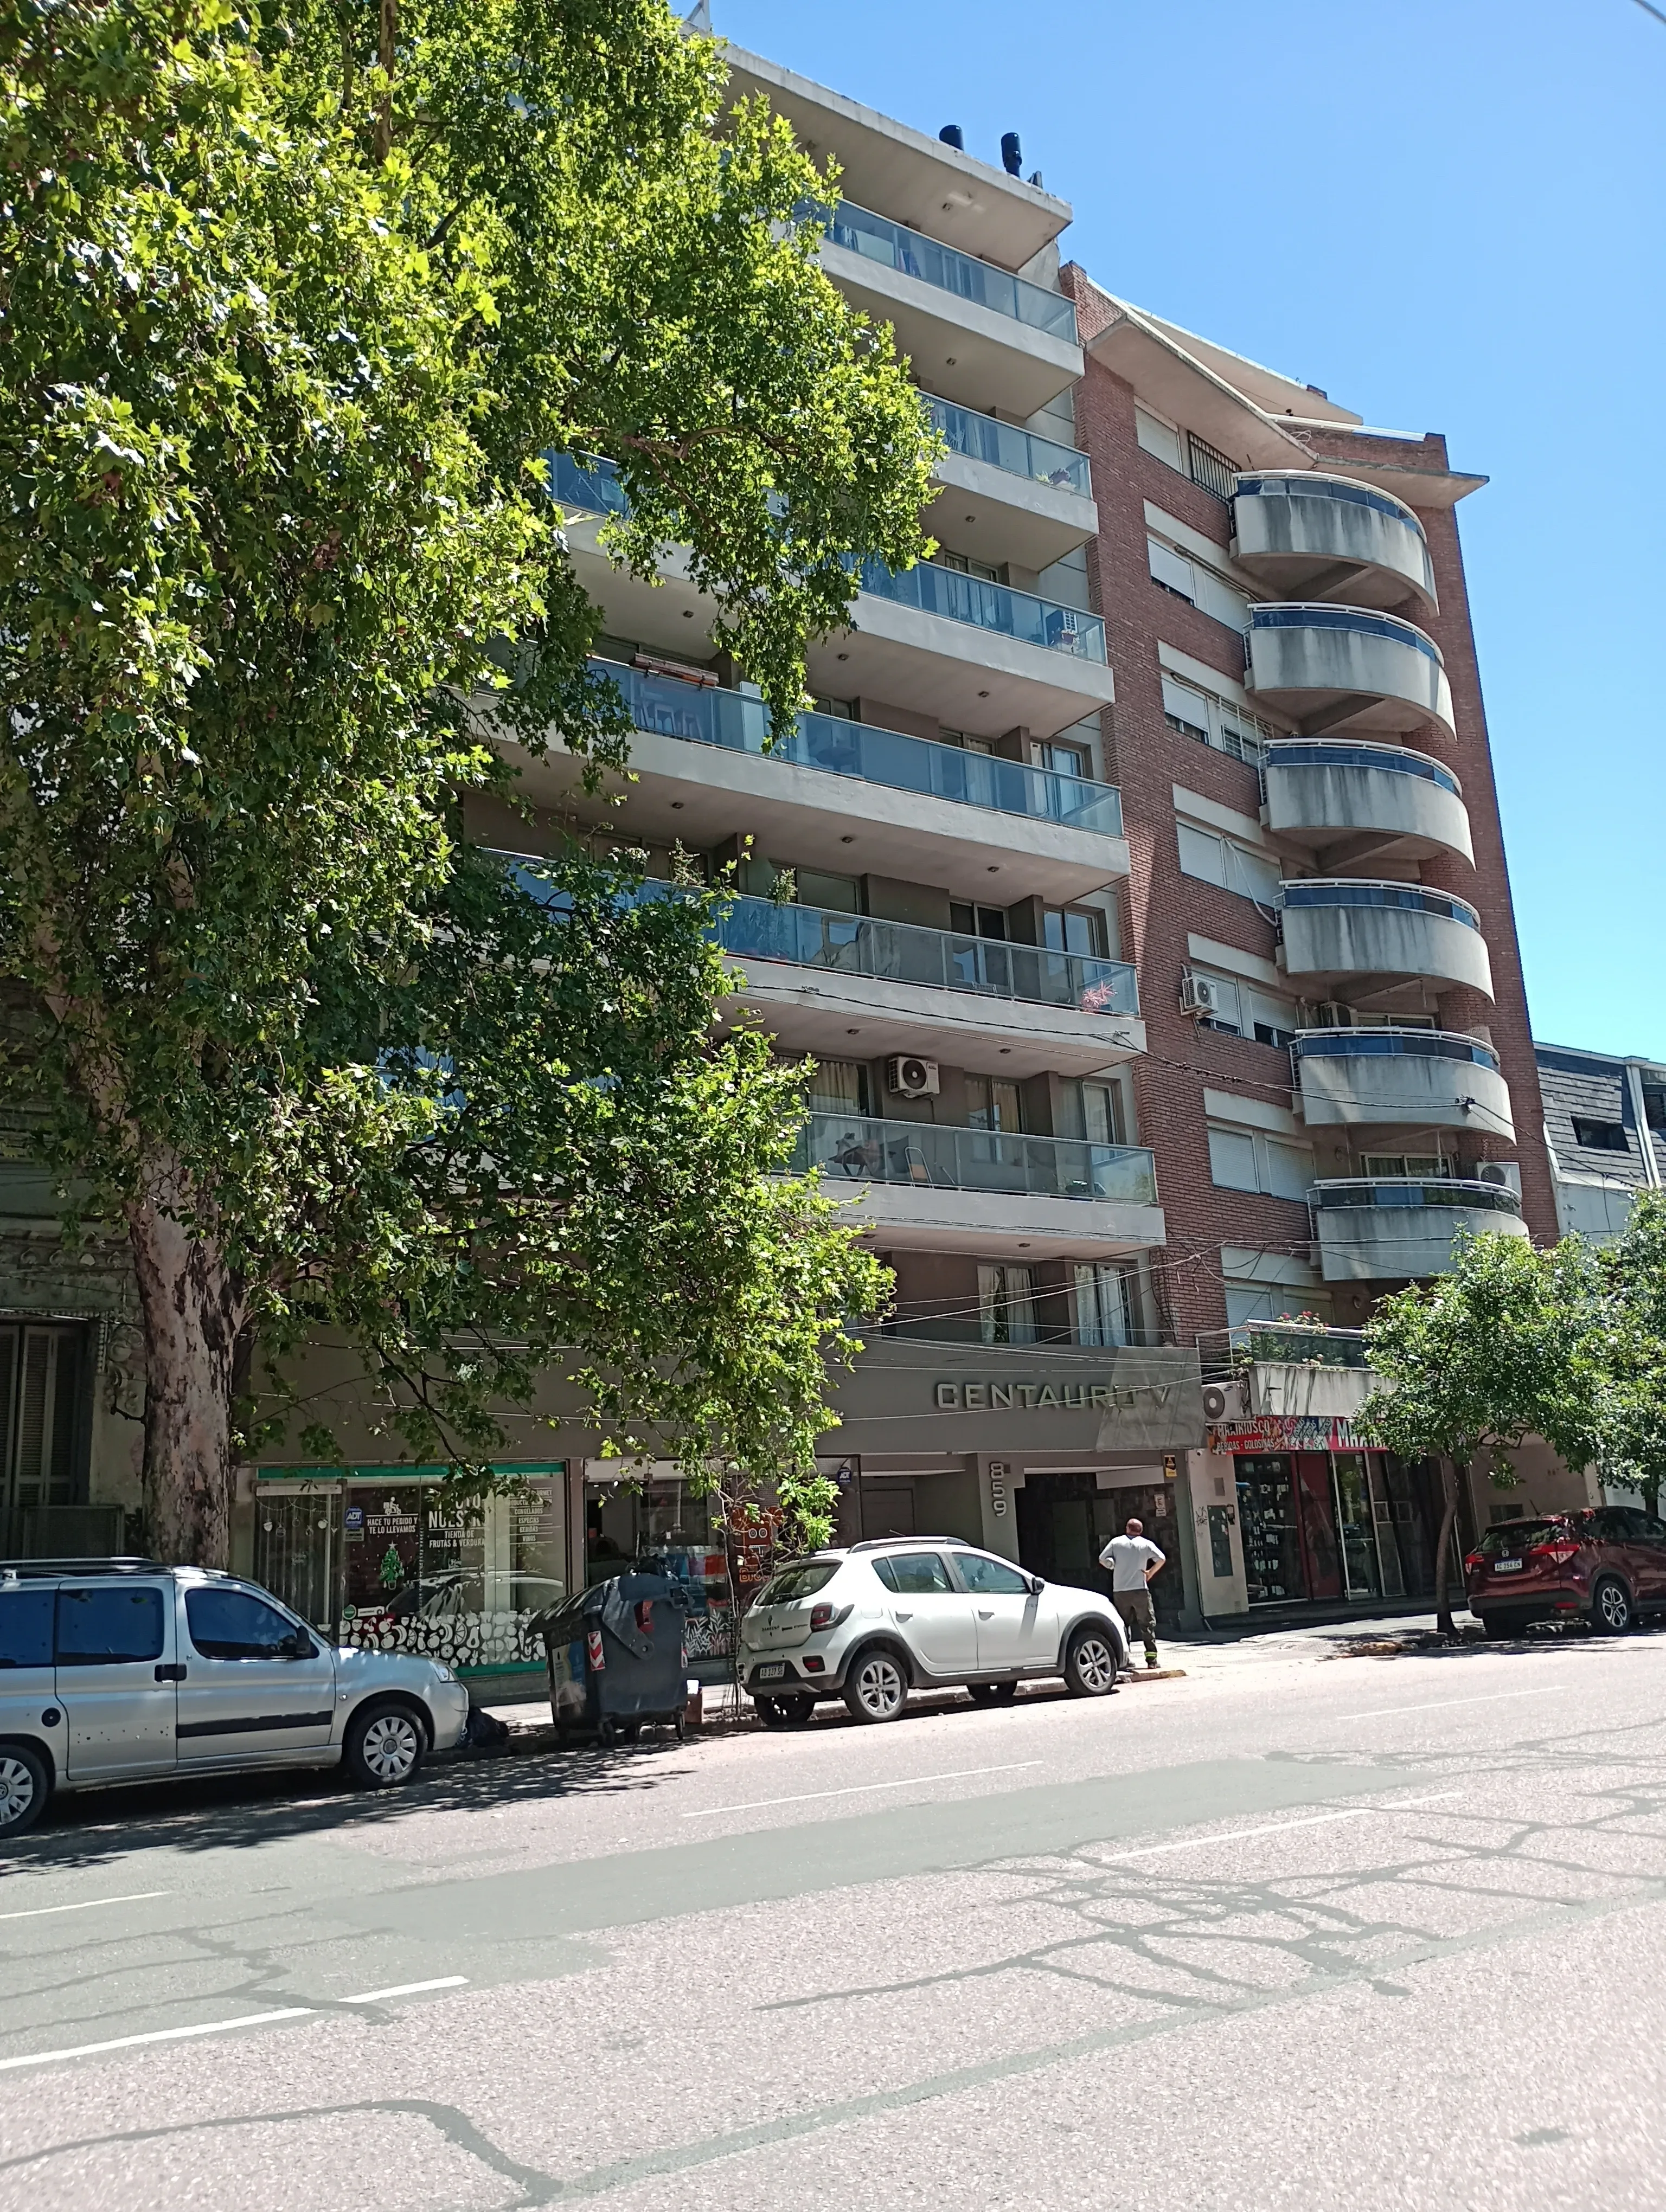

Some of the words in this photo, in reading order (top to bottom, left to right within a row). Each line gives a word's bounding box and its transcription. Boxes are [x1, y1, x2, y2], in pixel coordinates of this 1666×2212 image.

[1216, 1441, 1240, 1452] BEBIDAS
[1244, 1437, 1275, 1450] GOLOSINAS
[990, 1463, 1007, 1517] 859
[347, 1512, 362, 1520] ADT
[367, 1518, 382, 1526] HACE
[393, 1517, 412, 1526] PEDIDO
[369, 1526, 376, 1534] TE
[386, 1525, 416, 1534] LLEVAMOS
[445, 1530, 465, 1539] TIENDA
[467, 1529, 475, 1538] DE
[429, 1540, 451, 1548] FRUTAS
[453, 1539, 457, 1547] &
[459, 1538, 485, 1547] VERDURA
